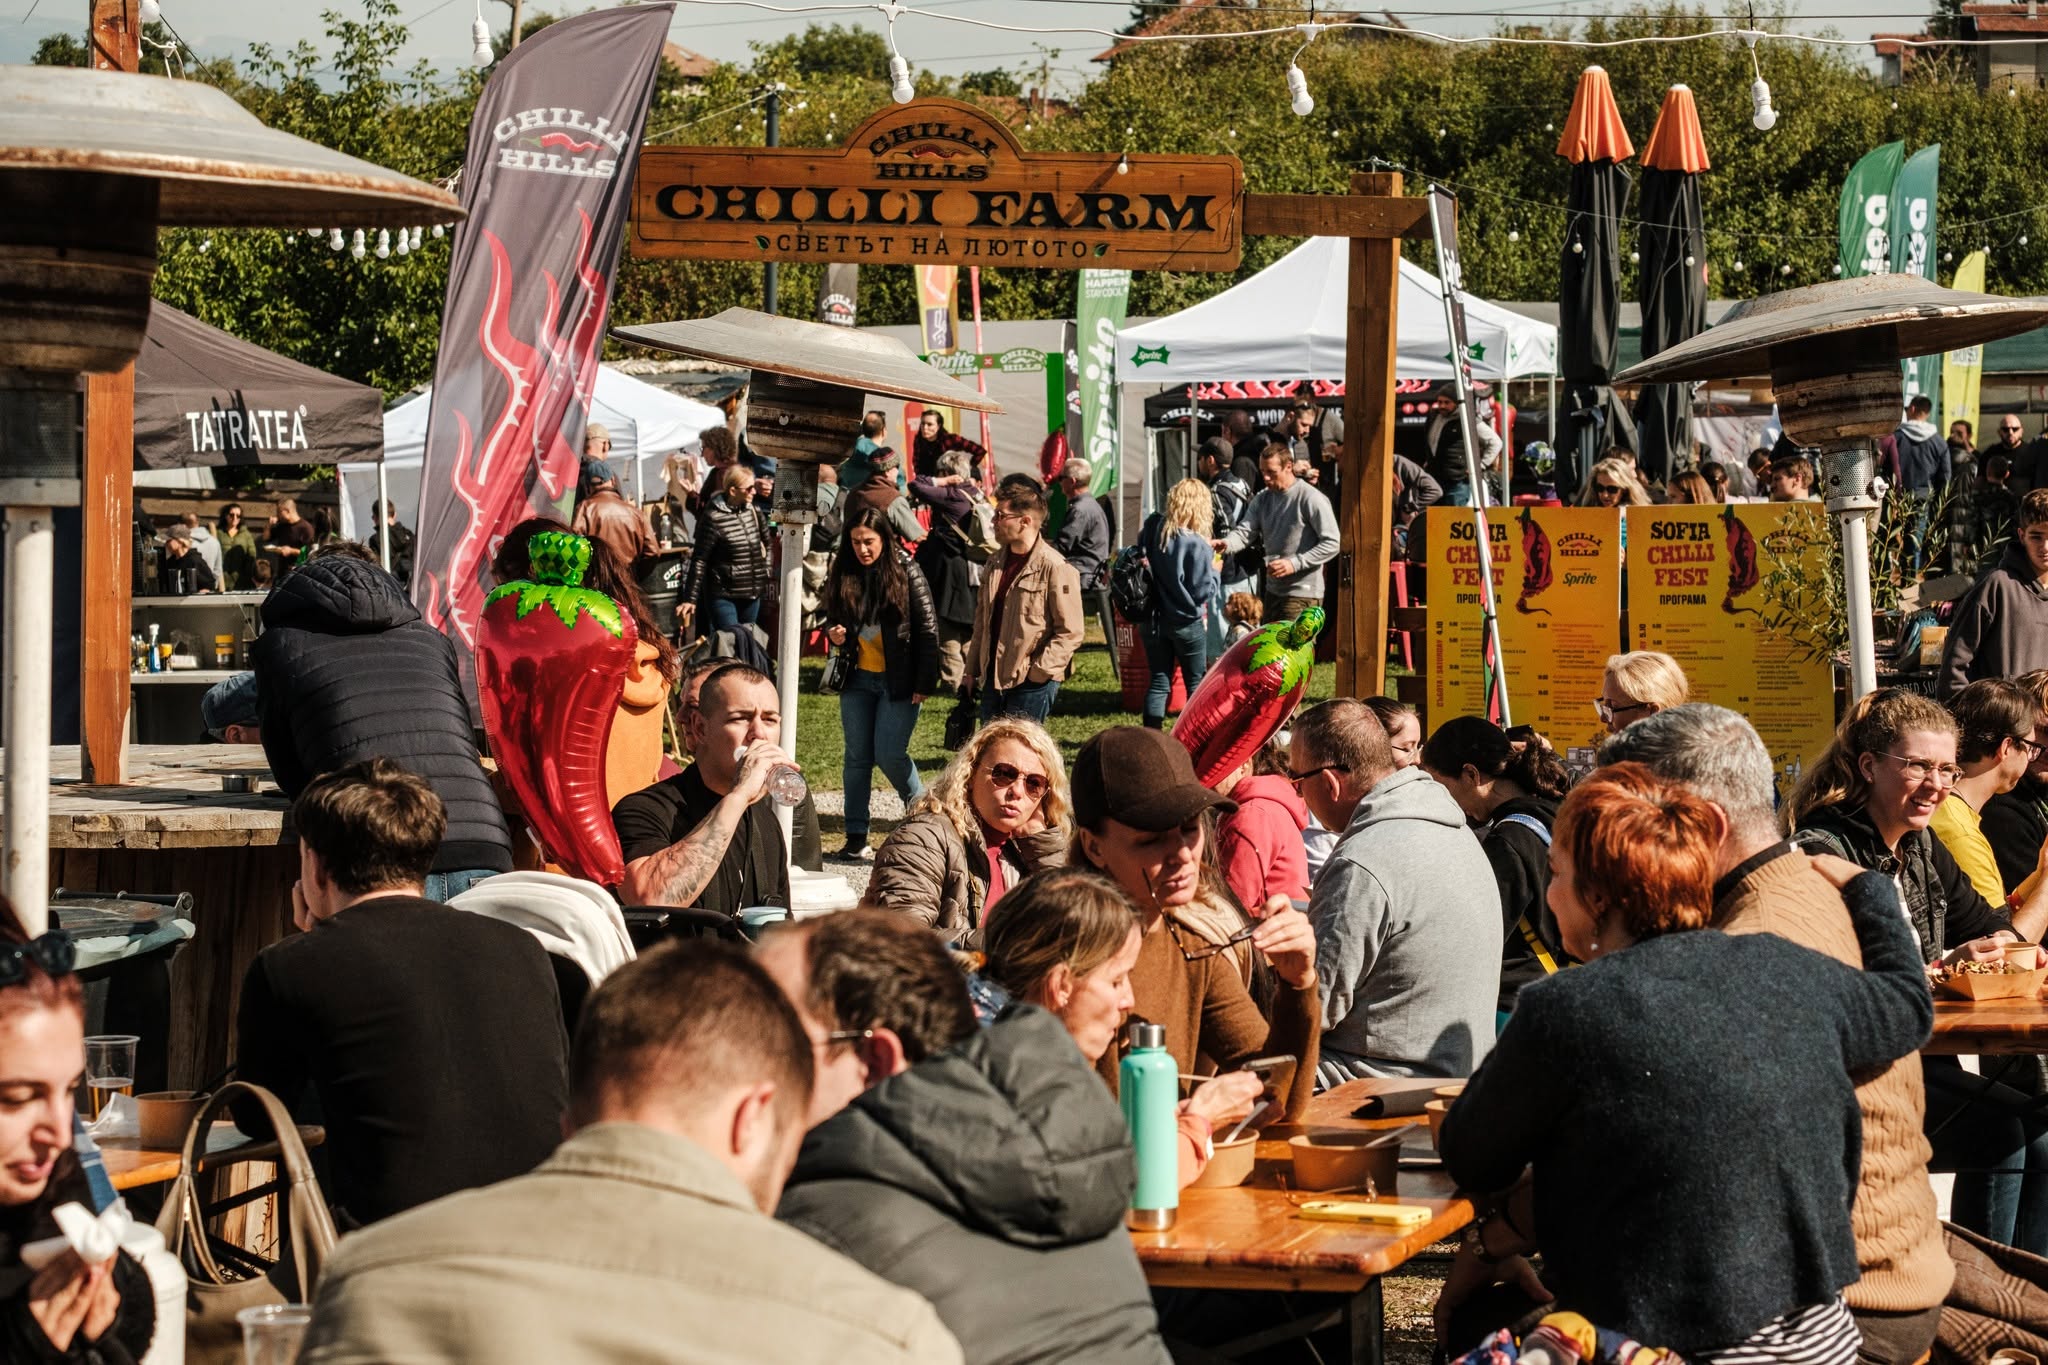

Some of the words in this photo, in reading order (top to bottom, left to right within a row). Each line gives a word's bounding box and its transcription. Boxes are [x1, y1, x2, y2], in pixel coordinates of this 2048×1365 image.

[493, 107, 630, 154] CHILLI
[869, 122, 999, 159] CHILLI
[498, 149, 617, 179] HILLS
[877, 163, 989, 181] HILLS
[656, 184, 944, 226] CHILLI
[967, 190, 1217, 232] FARM
[776, 234, 894, 255] СВЕТЪТ
[912, 237, 950, 255] НА
[963, 238, 1088, 258] ЛЮТОТО
[1137, 350, 1163, 362] Sprite
[1450, 521, 1508, 542] SOIA
[1557, 532, 1602, 547] CHILLI
[1651, 521, 1711, 541] SOFIA
[1446, 544, 1511, 565] CHILI
[1647, 543, 1716, 565] CHILLI
[1453, 567, 1505, 586] FET
[1563, 572, 1597, 587] Sprite
[1655, 567, 1709, 587] FEST
[1457, 593, 1502, 604] ПРОГА
[1660, 594, 1706, 605] ПРОГРАМА
